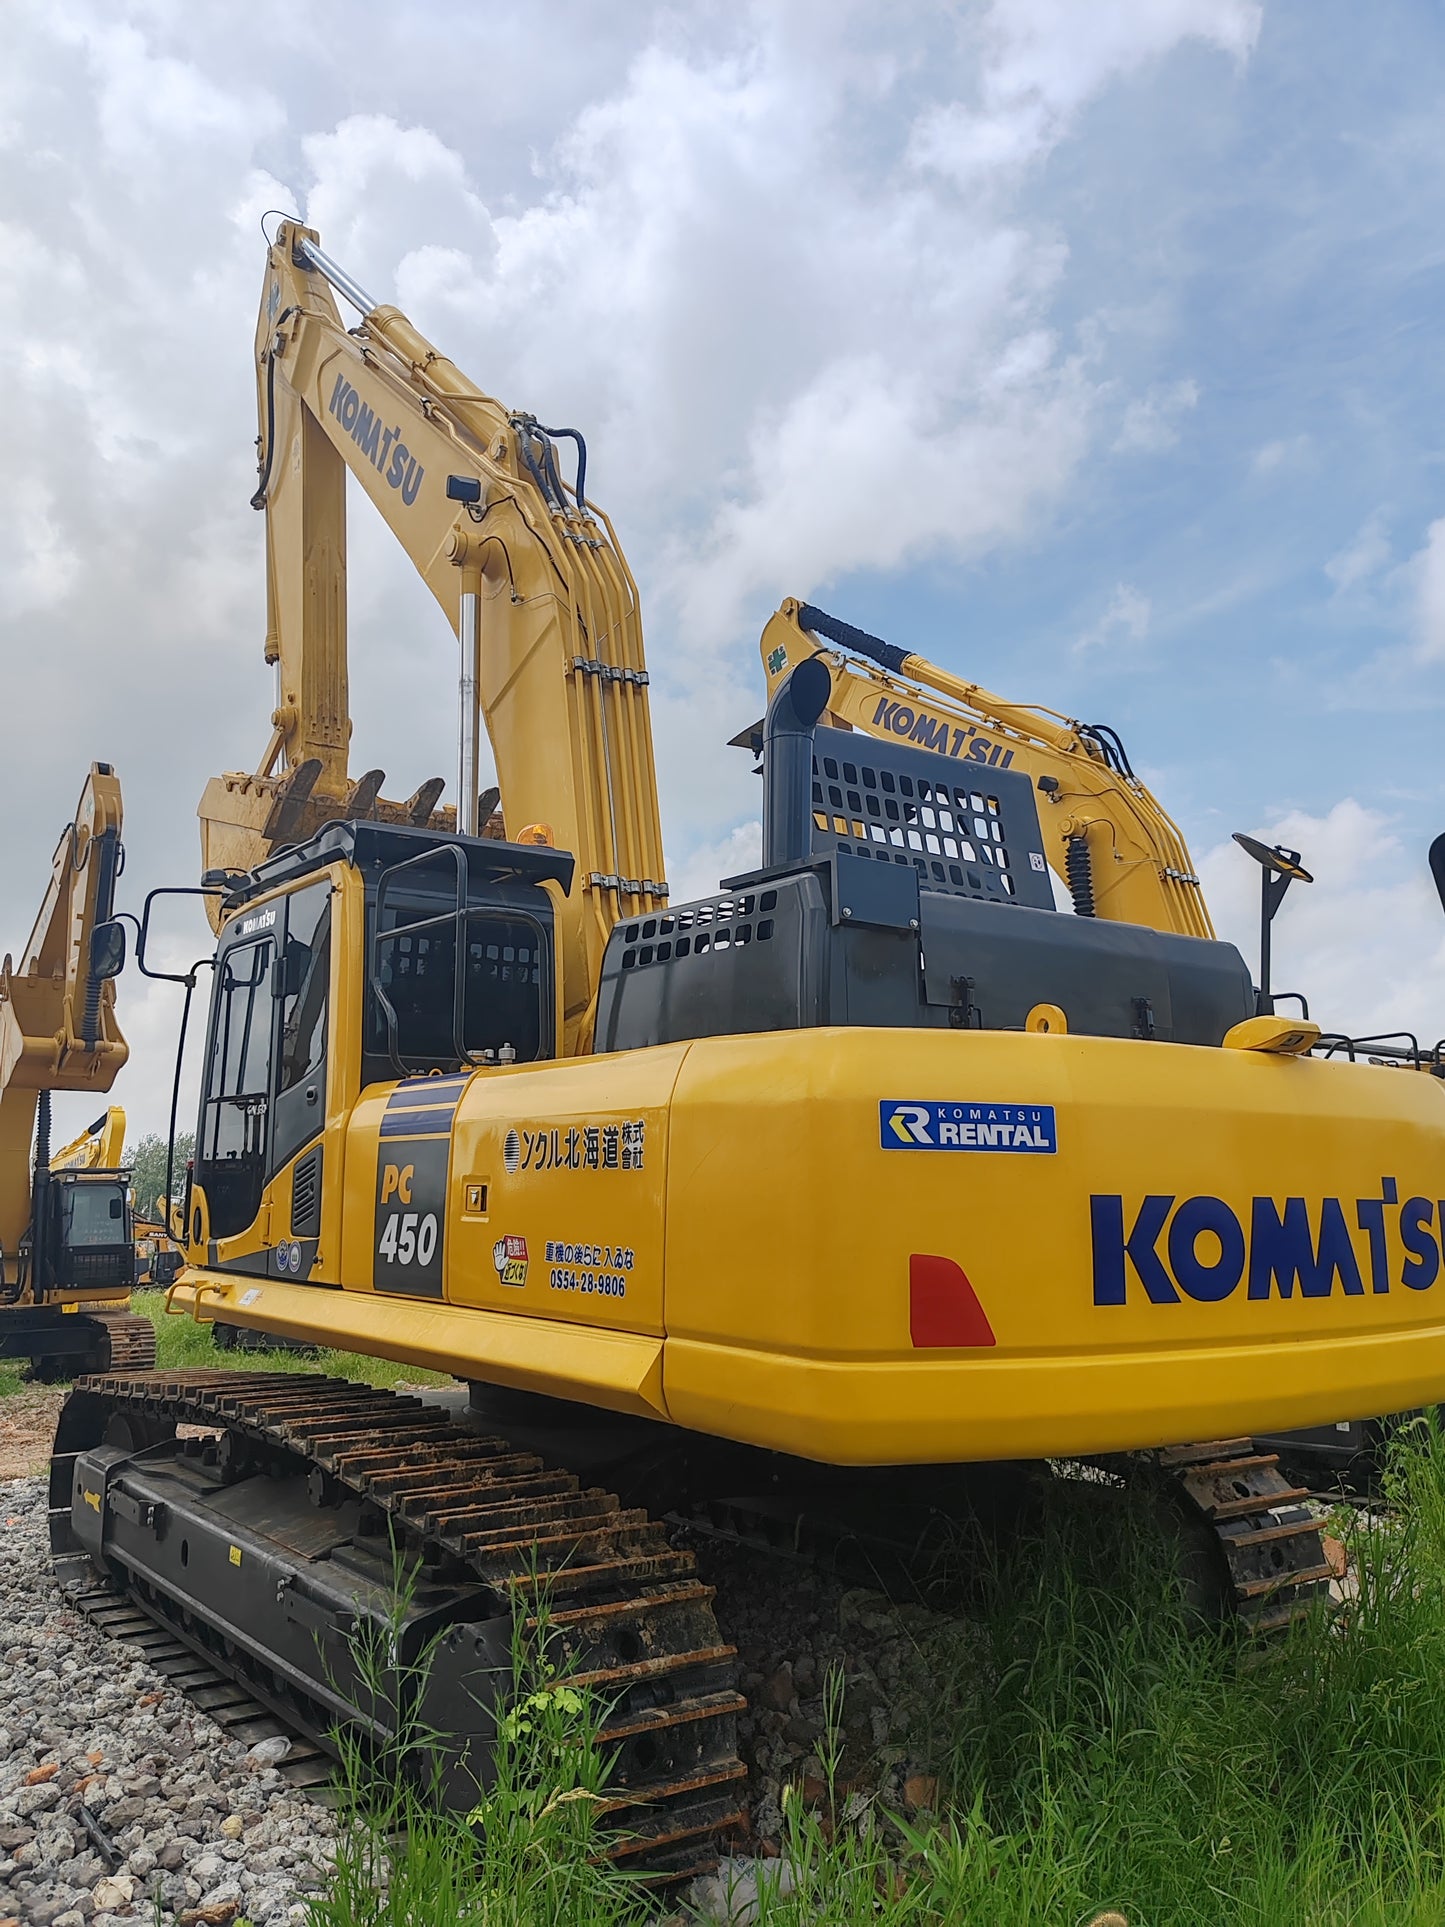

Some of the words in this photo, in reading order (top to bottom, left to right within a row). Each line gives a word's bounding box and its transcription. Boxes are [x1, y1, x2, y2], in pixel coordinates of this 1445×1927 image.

[329, 372, 424, 506] KOMATSU
[871, 696, 1015, 769] KOMATSU
[243, 909, 276, 935] KOMATSU
[938, 1108, 1041, 1121] KOMATSU
[939, 1122, 1050, 1147] RENTAL
[381, 1164, 415, 1205] PC
[379, 1213, 438, 1267] 450
[1090, 1176, 1445, 1306] KOMATS
